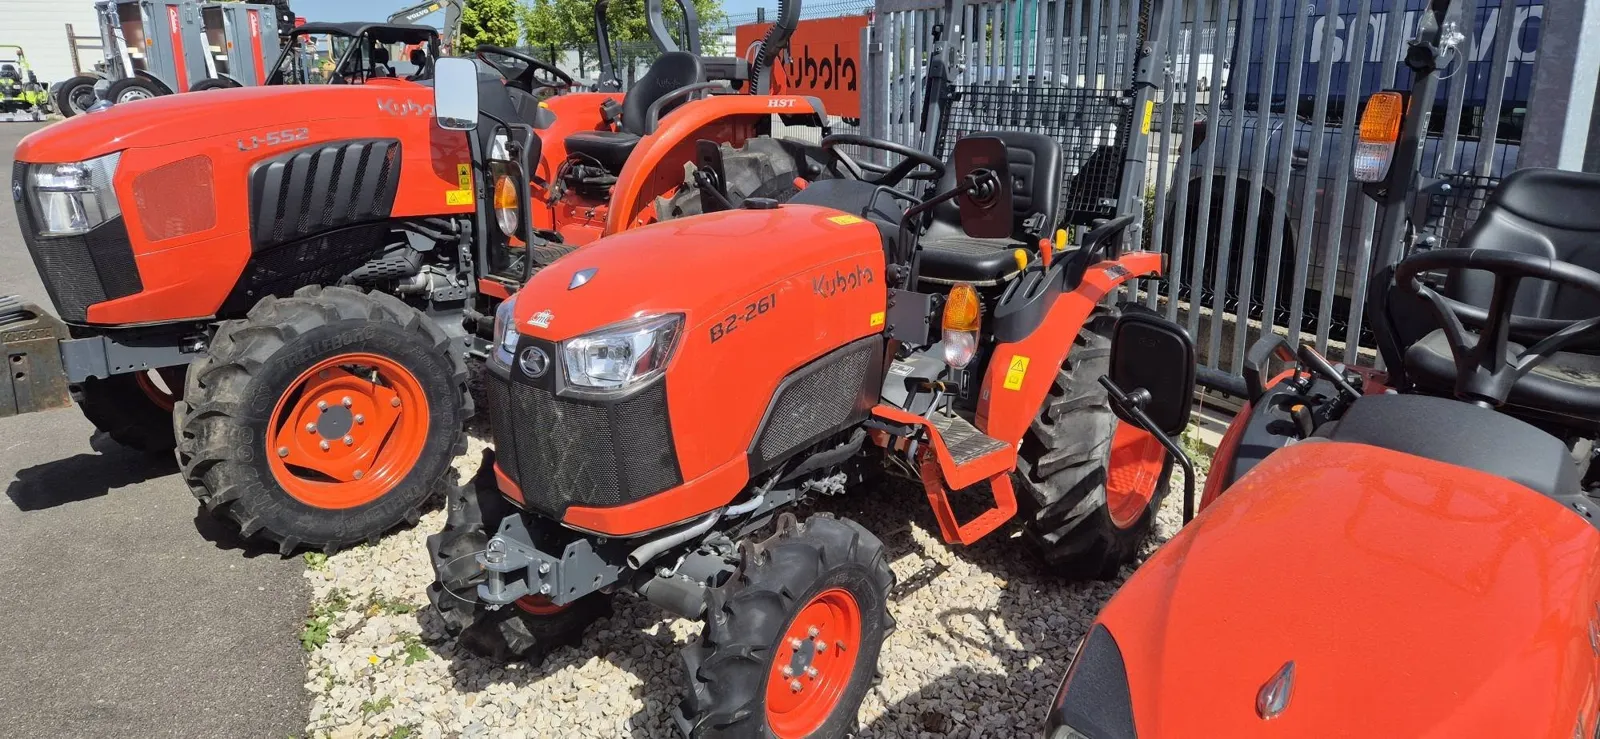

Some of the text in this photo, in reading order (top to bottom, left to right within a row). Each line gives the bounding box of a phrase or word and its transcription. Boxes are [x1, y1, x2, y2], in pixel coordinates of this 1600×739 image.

[406, 8, 429, 21] VOLVO
[376, 98, 436, 116] Kubo
[768, 99, 796, 107] HST
[812, 264, 874, 299] Kubota
[709, 293, 776, 344] B2-261
